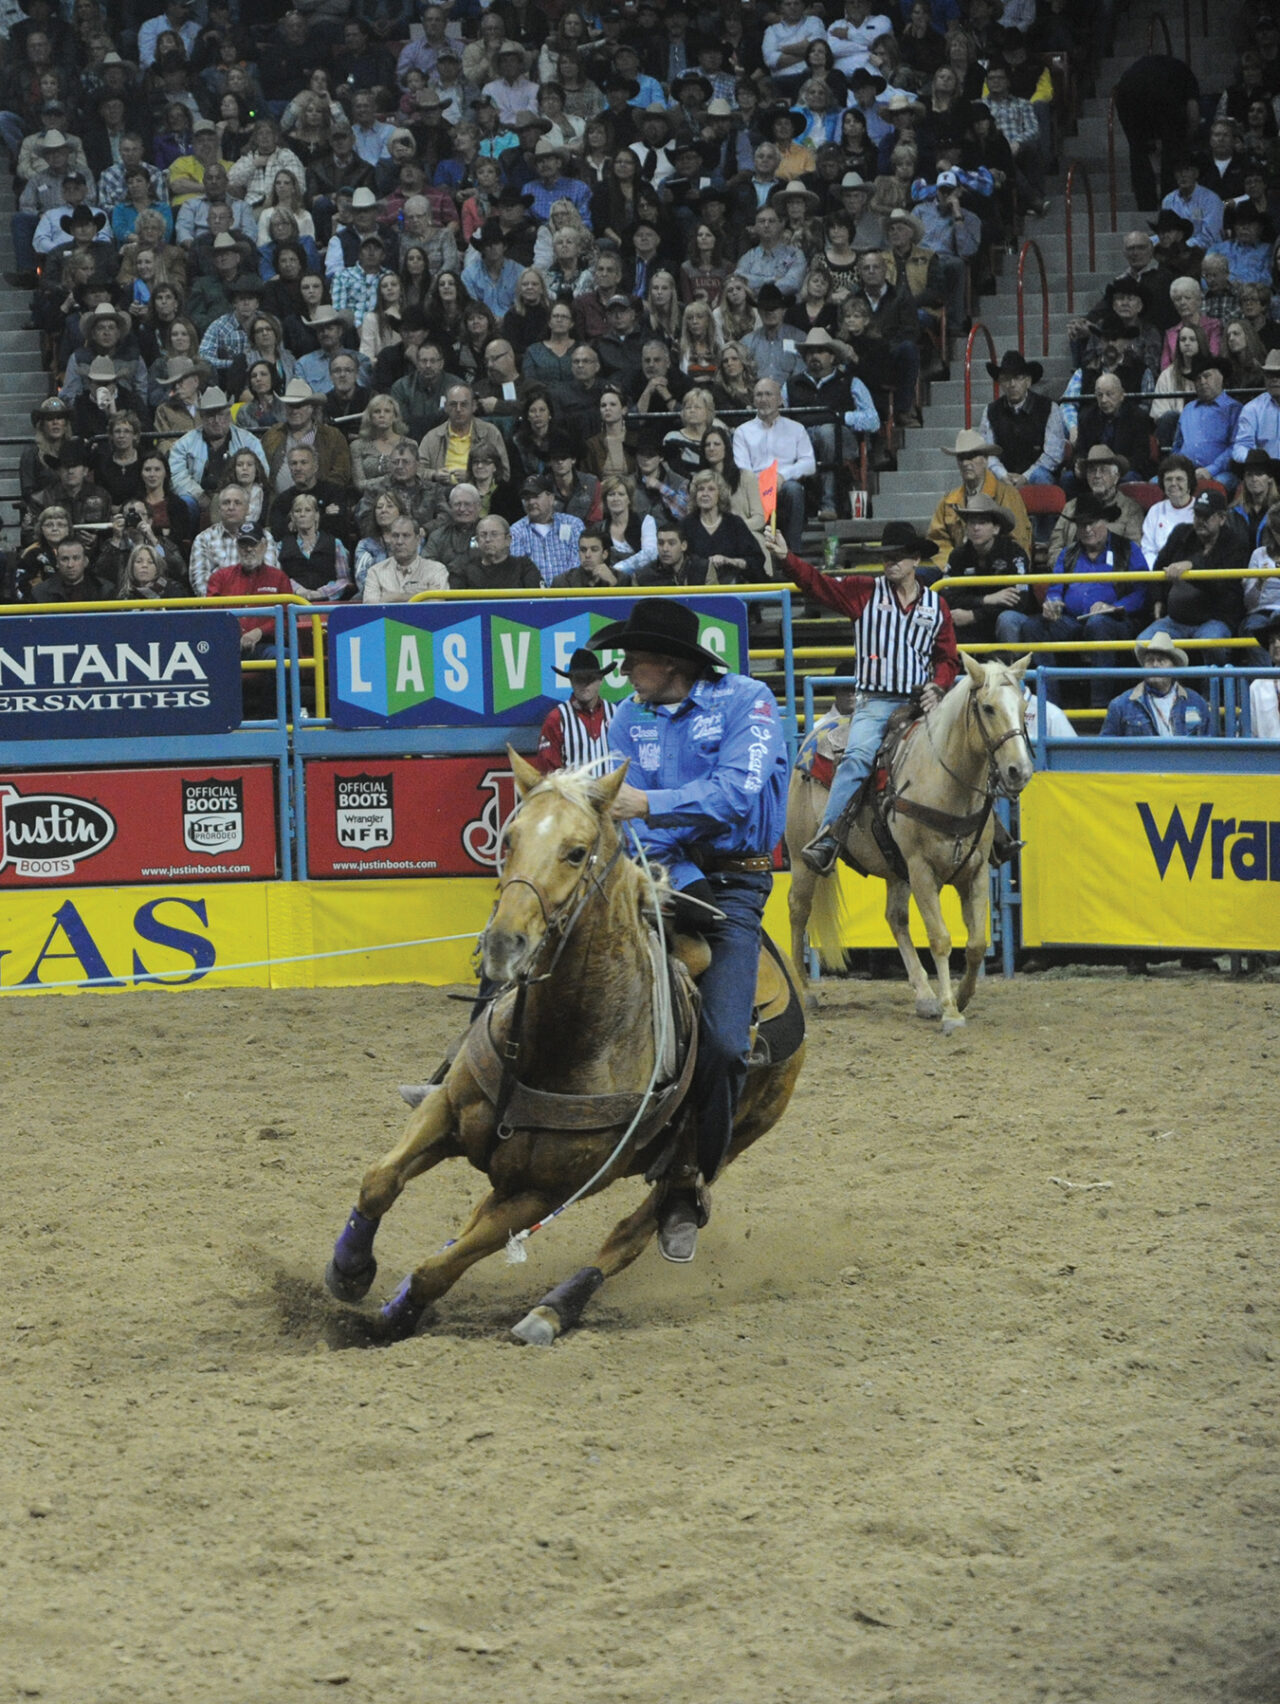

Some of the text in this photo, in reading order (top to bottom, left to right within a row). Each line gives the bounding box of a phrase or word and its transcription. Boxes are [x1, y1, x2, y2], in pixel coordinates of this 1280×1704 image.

[349, 627, 729, 693] LAS VEGS
[186, 786, 237, 799] OFFICIAL
[338, 781, 388, 793] OFFICIAL
[186, 797, 238, 811] BOOTS
[339, 793, 388, 807] BOOTS
[344, 814, 384, 826] Wrangler
[194, 831, 237, 840] PRORODEO
[341, 828, 389, 842] NFR
[20, 859, 71, 873] BOOTS
[141, 863, 251, 877] www.justinboots.com
[332, 860, 438, 871] www.justinboots.com
